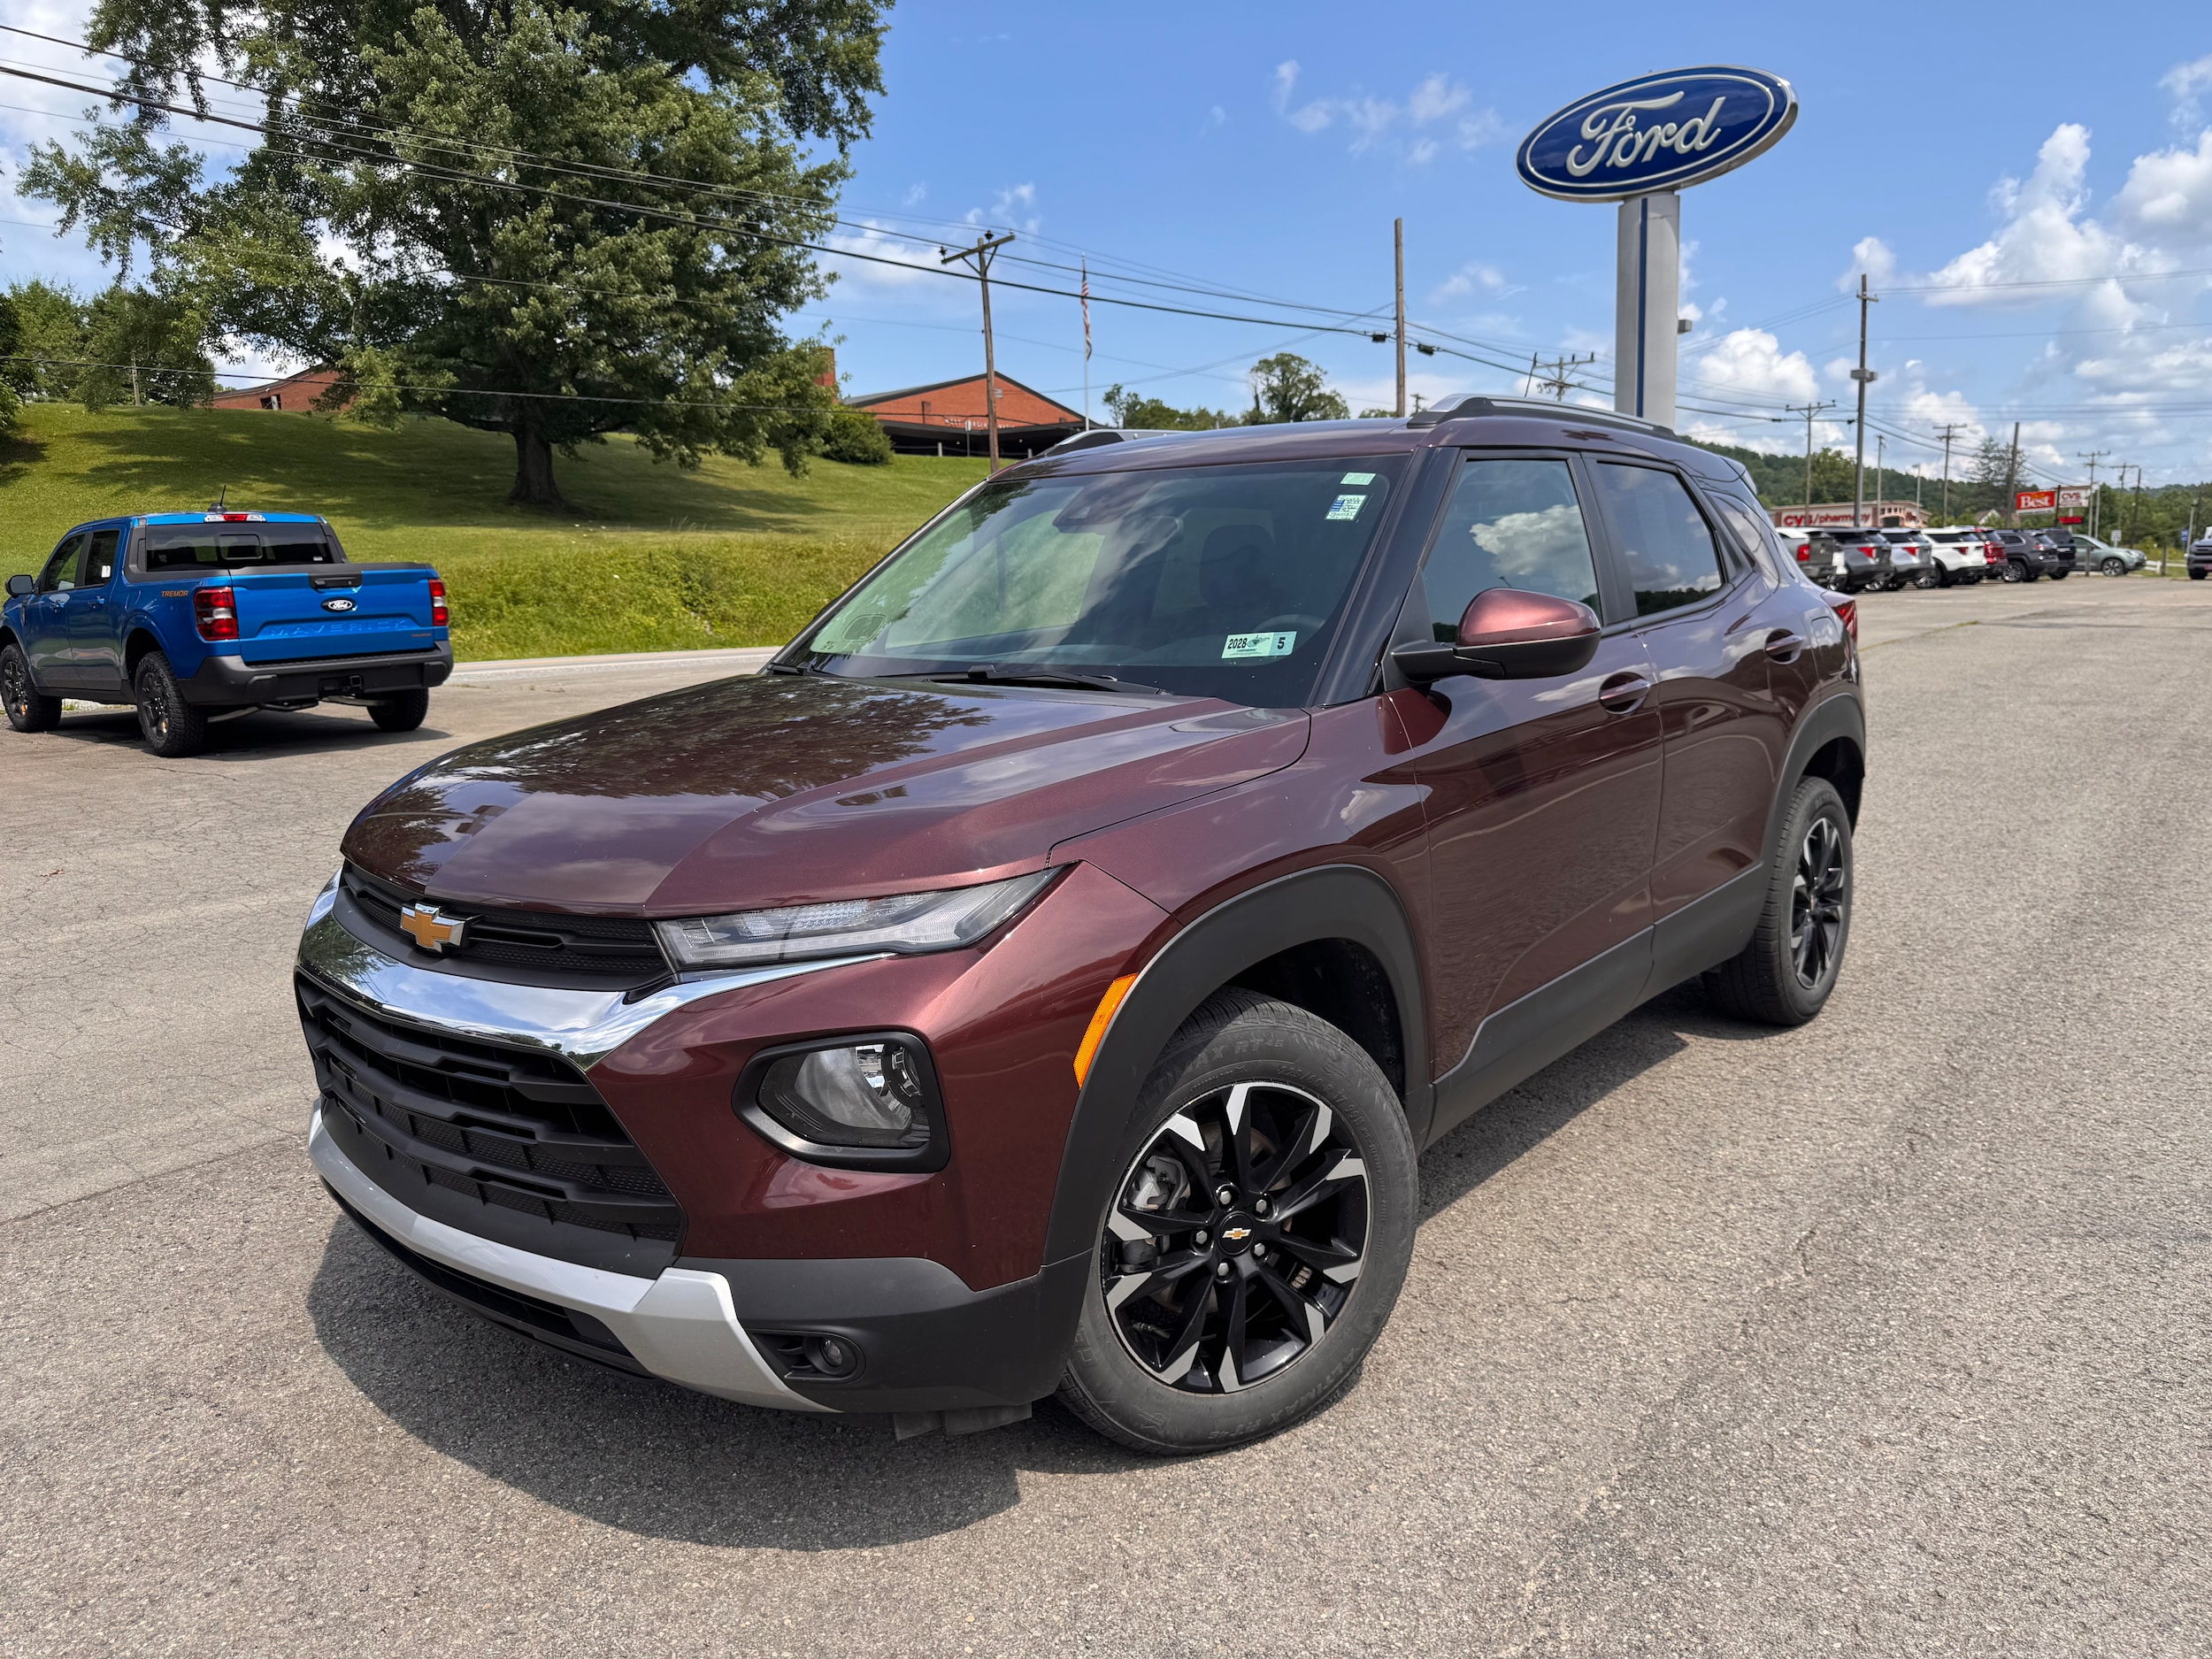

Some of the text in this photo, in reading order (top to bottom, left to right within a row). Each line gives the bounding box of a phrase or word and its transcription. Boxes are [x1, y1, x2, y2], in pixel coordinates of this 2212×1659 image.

[1566, 90, 1727, 178] Ford
[2020, 495, 2050, 509] Best
[271, 619, 408, 636] MAVERICK
[1227, 636, 1286, 649] 2028 5
